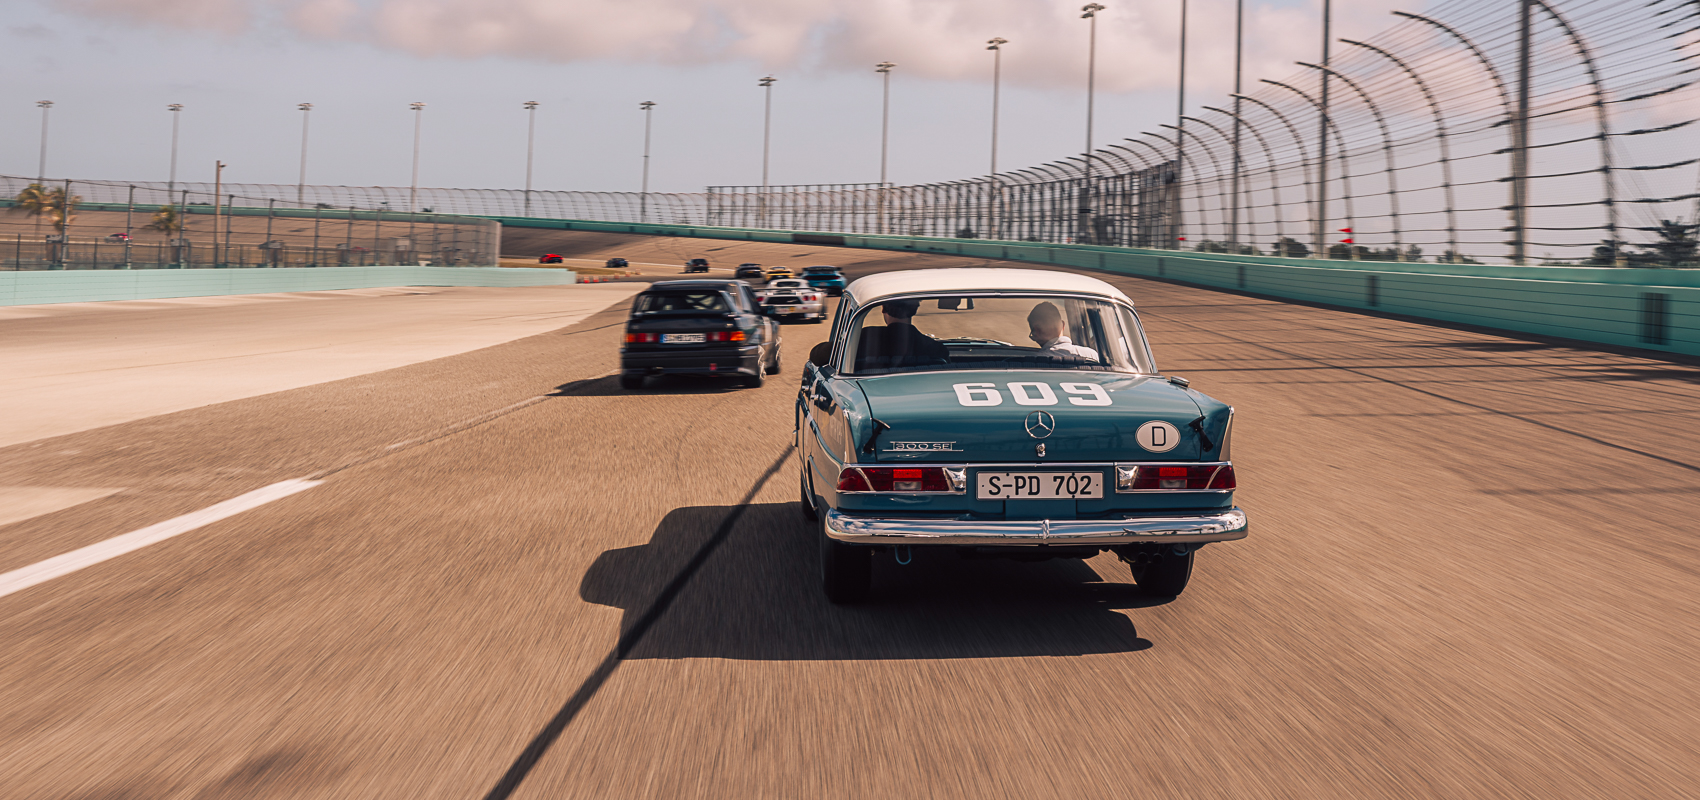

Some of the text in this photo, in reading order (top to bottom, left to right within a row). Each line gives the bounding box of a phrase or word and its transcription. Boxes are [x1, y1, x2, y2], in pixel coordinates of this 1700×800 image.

[952, 382, 1113, 407] 609
[1151, 426, 1167, 447] D
[988, 475, 1092, 496] S-PD 702
